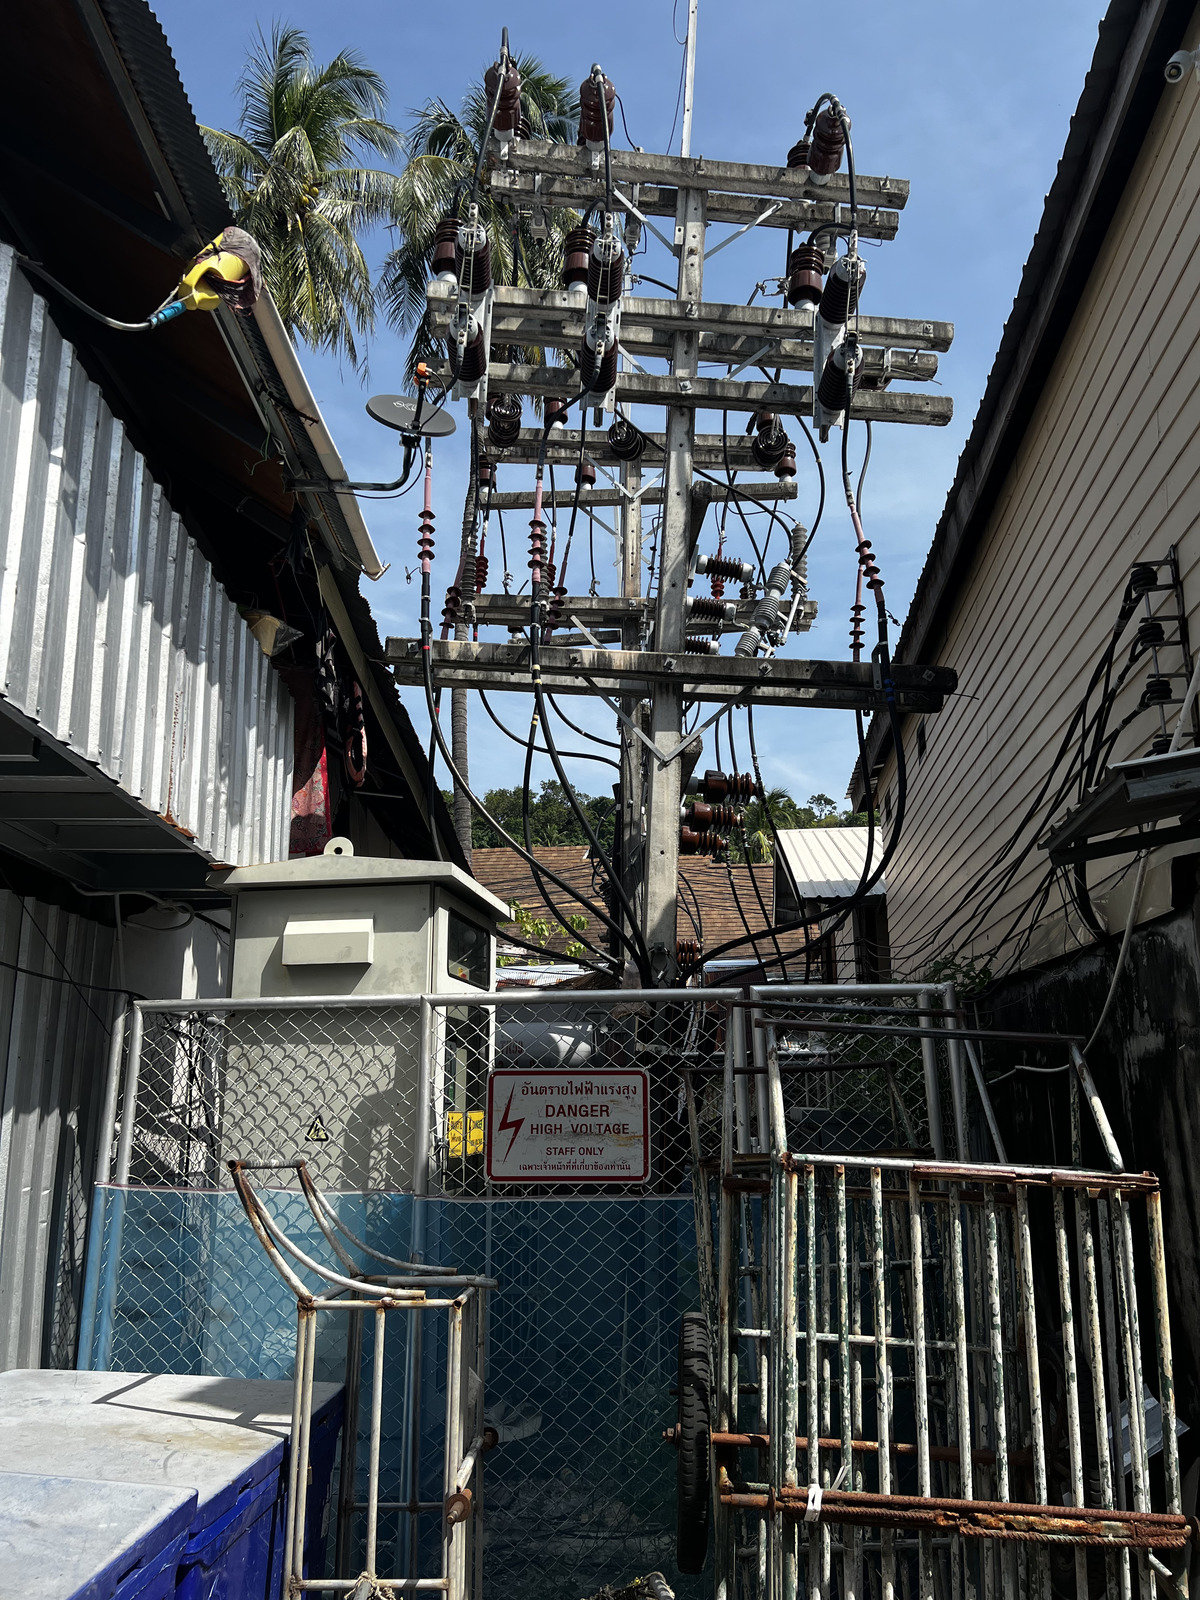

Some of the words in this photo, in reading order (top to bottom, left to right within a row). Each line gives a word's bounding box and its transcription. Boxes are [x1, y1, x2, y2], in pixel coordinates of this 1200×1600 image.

[521, 1080, 637, 1099] อันตรายไฟฟ้าแรงสูง
[546, 1105, 610, 1117] DANGER
[530, 1124, 563, 1134] HIGH
[571, 1124, 629, 1135] VOLTAGE
[546, 1147, 575, 1156] STAFF
[578, 1147, 604, 1156] ONLY
[519, 1159, 631, 1171] เฉพาะเจ้าหน้าที่ที่เกี่ยวข้องเท่านั้น
